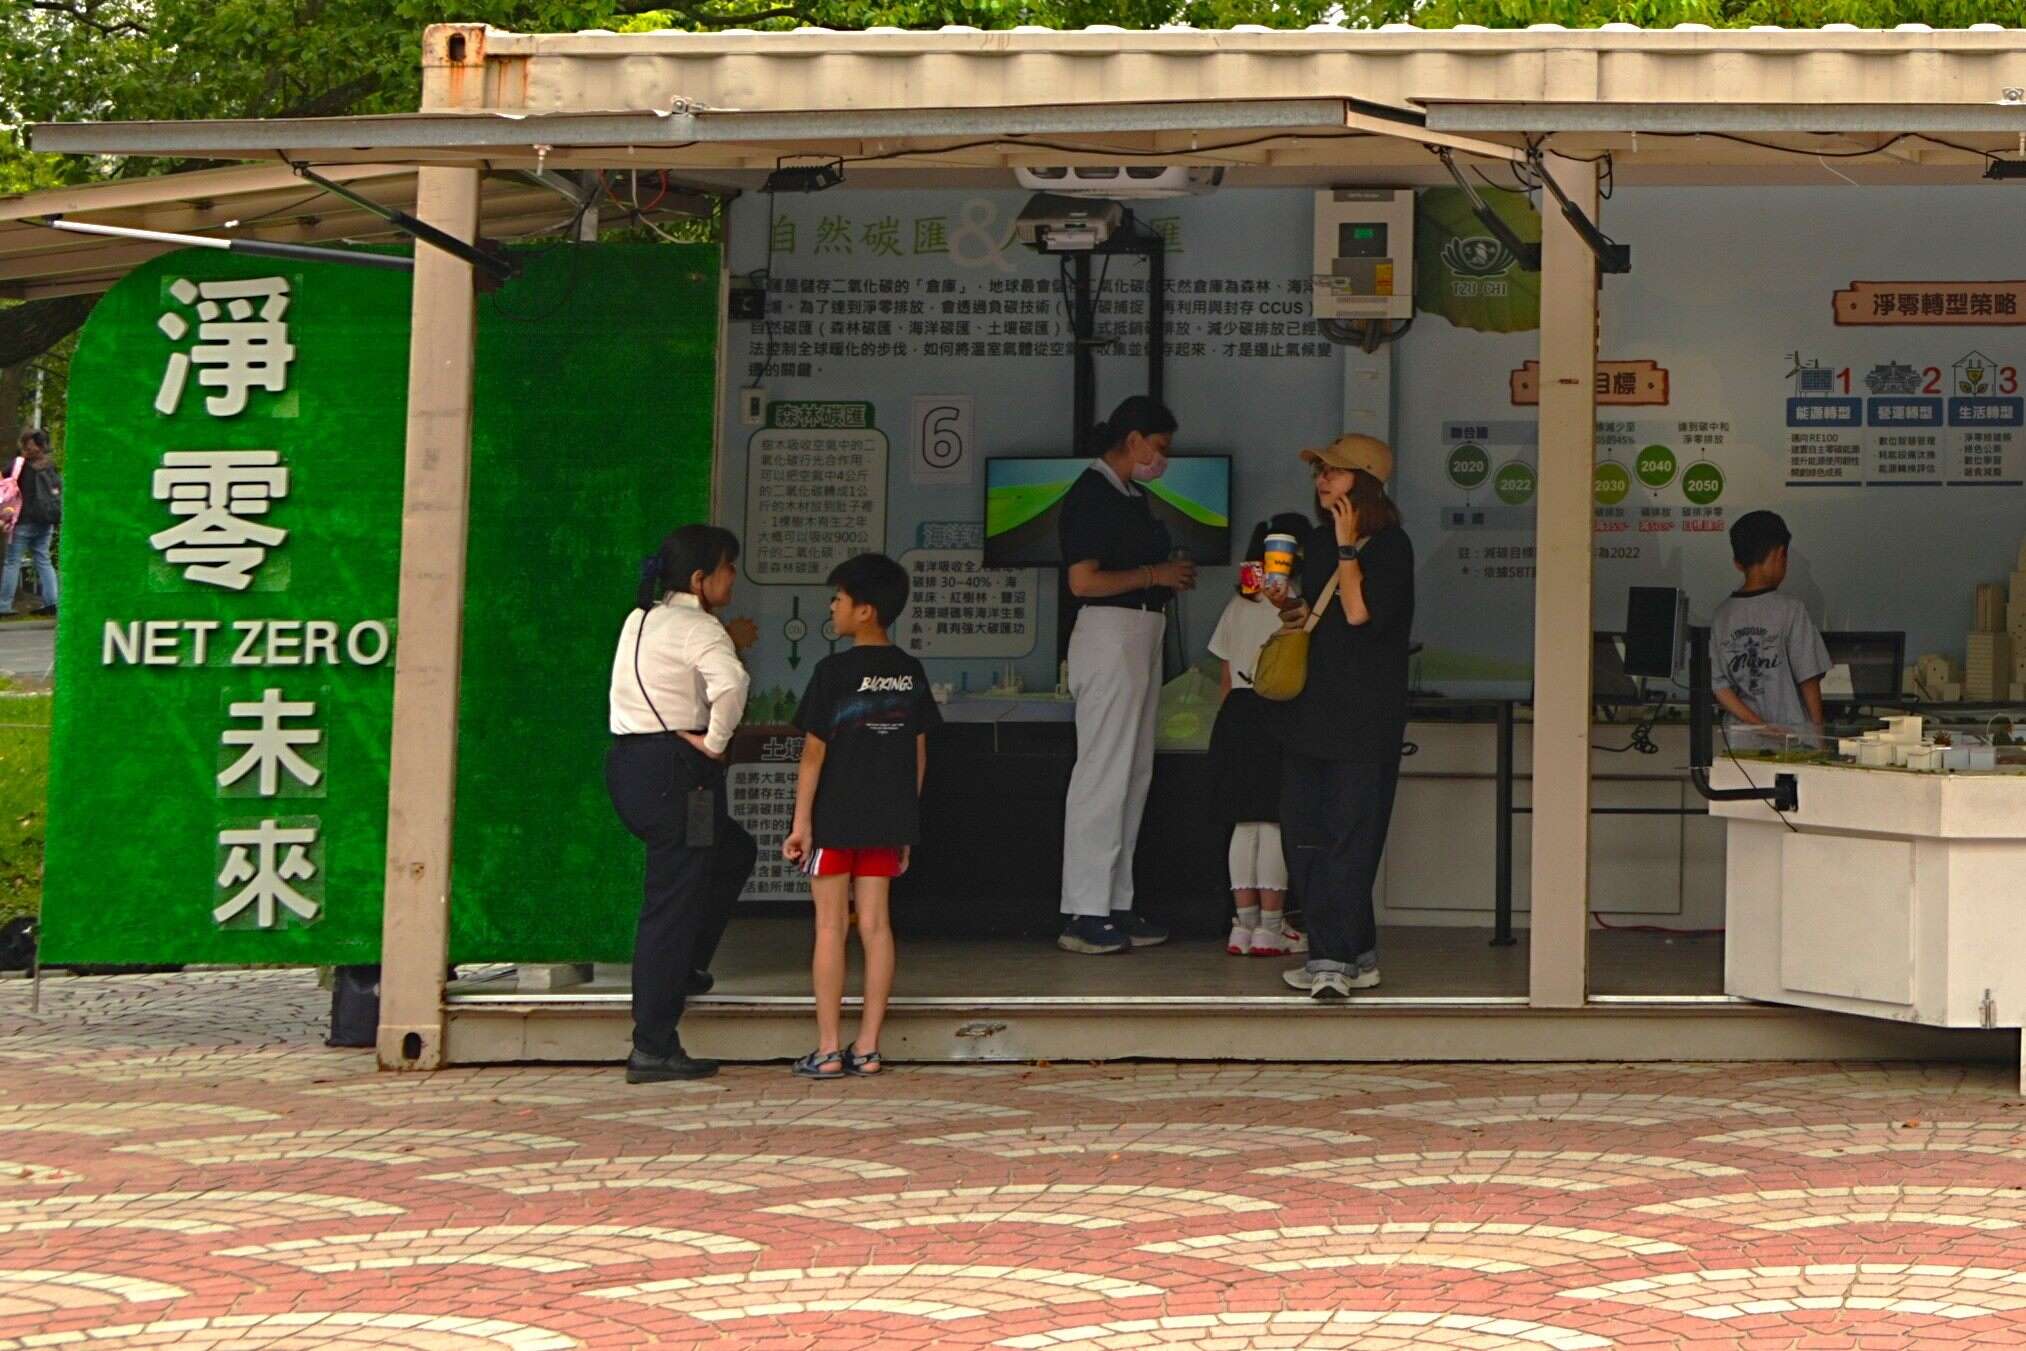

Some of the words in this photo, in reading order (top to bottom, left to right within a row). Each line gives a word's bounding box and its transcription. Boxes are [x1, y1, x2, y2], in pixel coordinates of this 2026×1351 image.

[770, 214, 950, 257] 自然碳匯
[1872, 292, 2018, 316] 淨零轉型策略
[1836, 367, 1851, 395] 1
[1921, 366, 1942, 395] 2
[1999, 366, 2019, 395] 3
[776, 404, 866, 427] 森林碳匯
[1959, 405, 2014, 420] 生活轉型
[922, 405, 962, 469] 6
[1453, 460, 1485, 473] 2020
[1641, 460, 1673, 473] 2040
[1500, 479, 1533, 491] 2022
[1595, 479, 1626, 492] 2030
[1687, 479, 1720, 492] 2050
[102, 619, 220, 666] NET
[231, 618, 390, 666] ZERO
[213, 687, 322, 928] 未來
